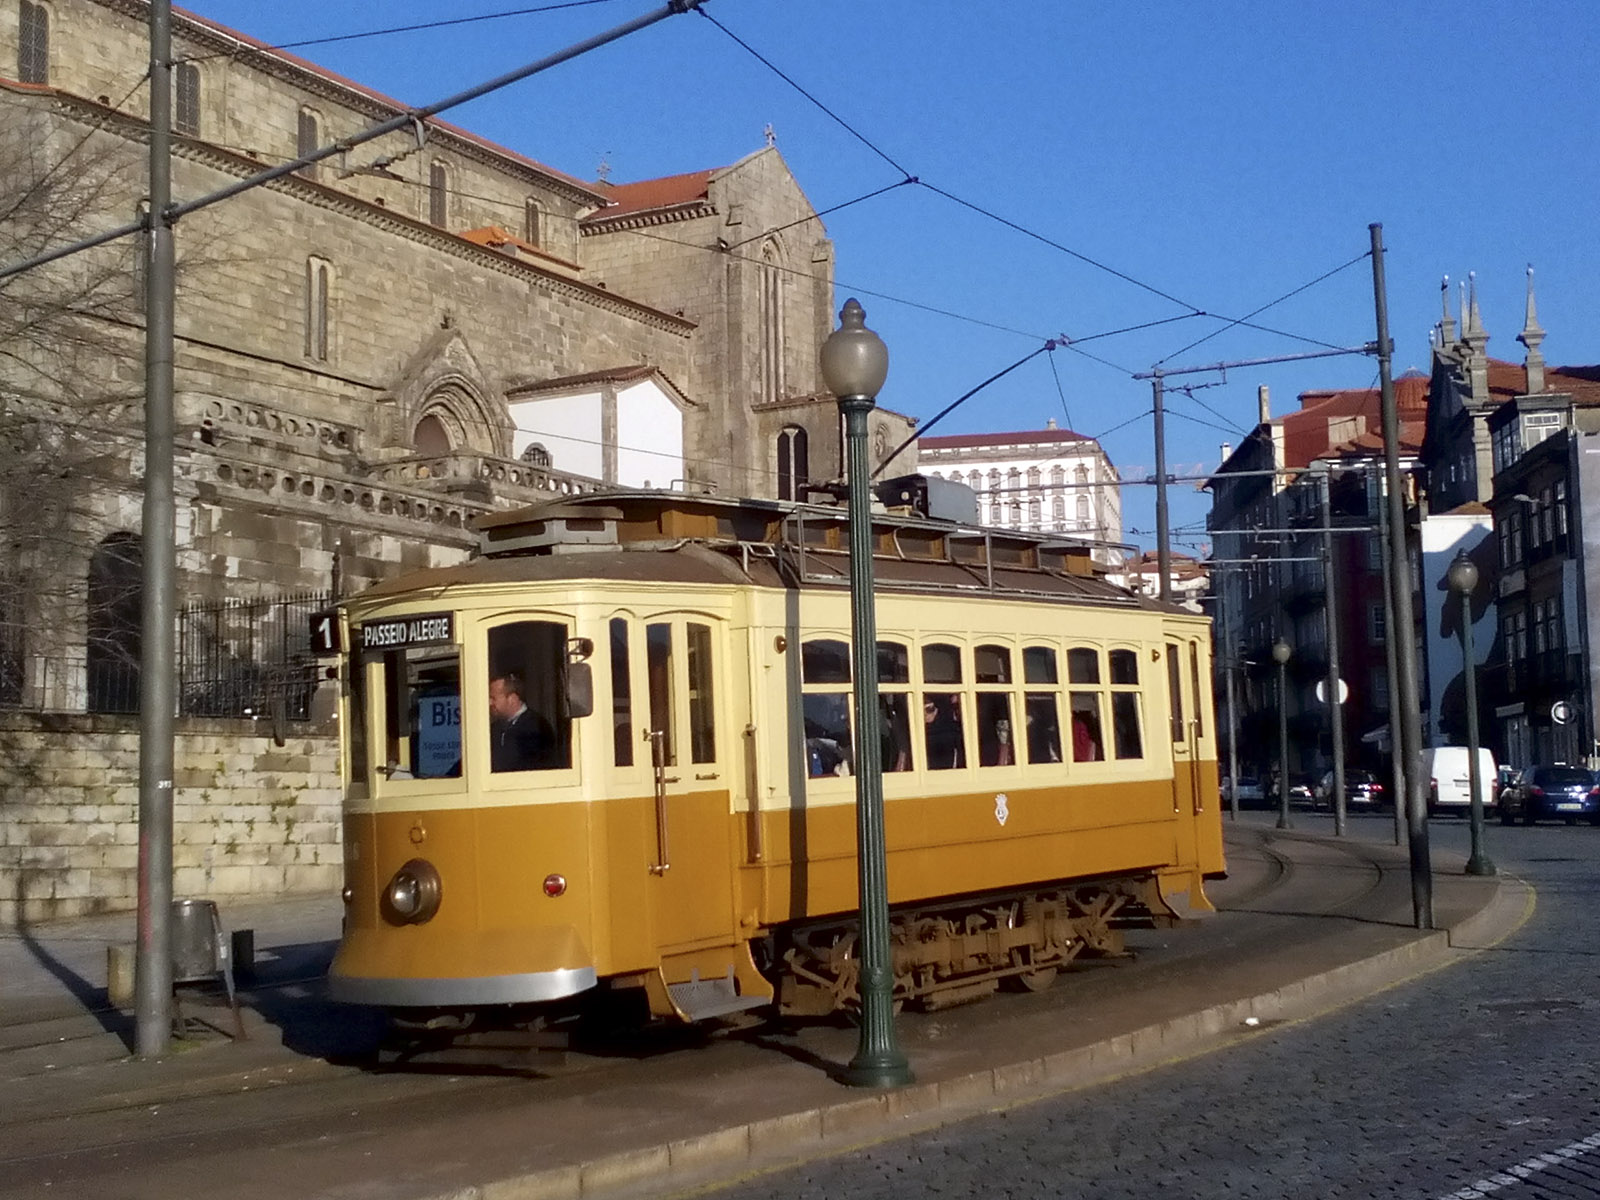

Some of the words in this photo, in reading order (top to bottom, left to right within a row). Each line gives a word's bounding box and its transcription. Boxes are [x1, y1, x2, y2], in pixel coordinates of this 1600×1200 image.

[319, 618, 332, 649] 1
[364, 622, 407, 647] PASSEIO
[409, 618, 449, 642] ALEGRE
